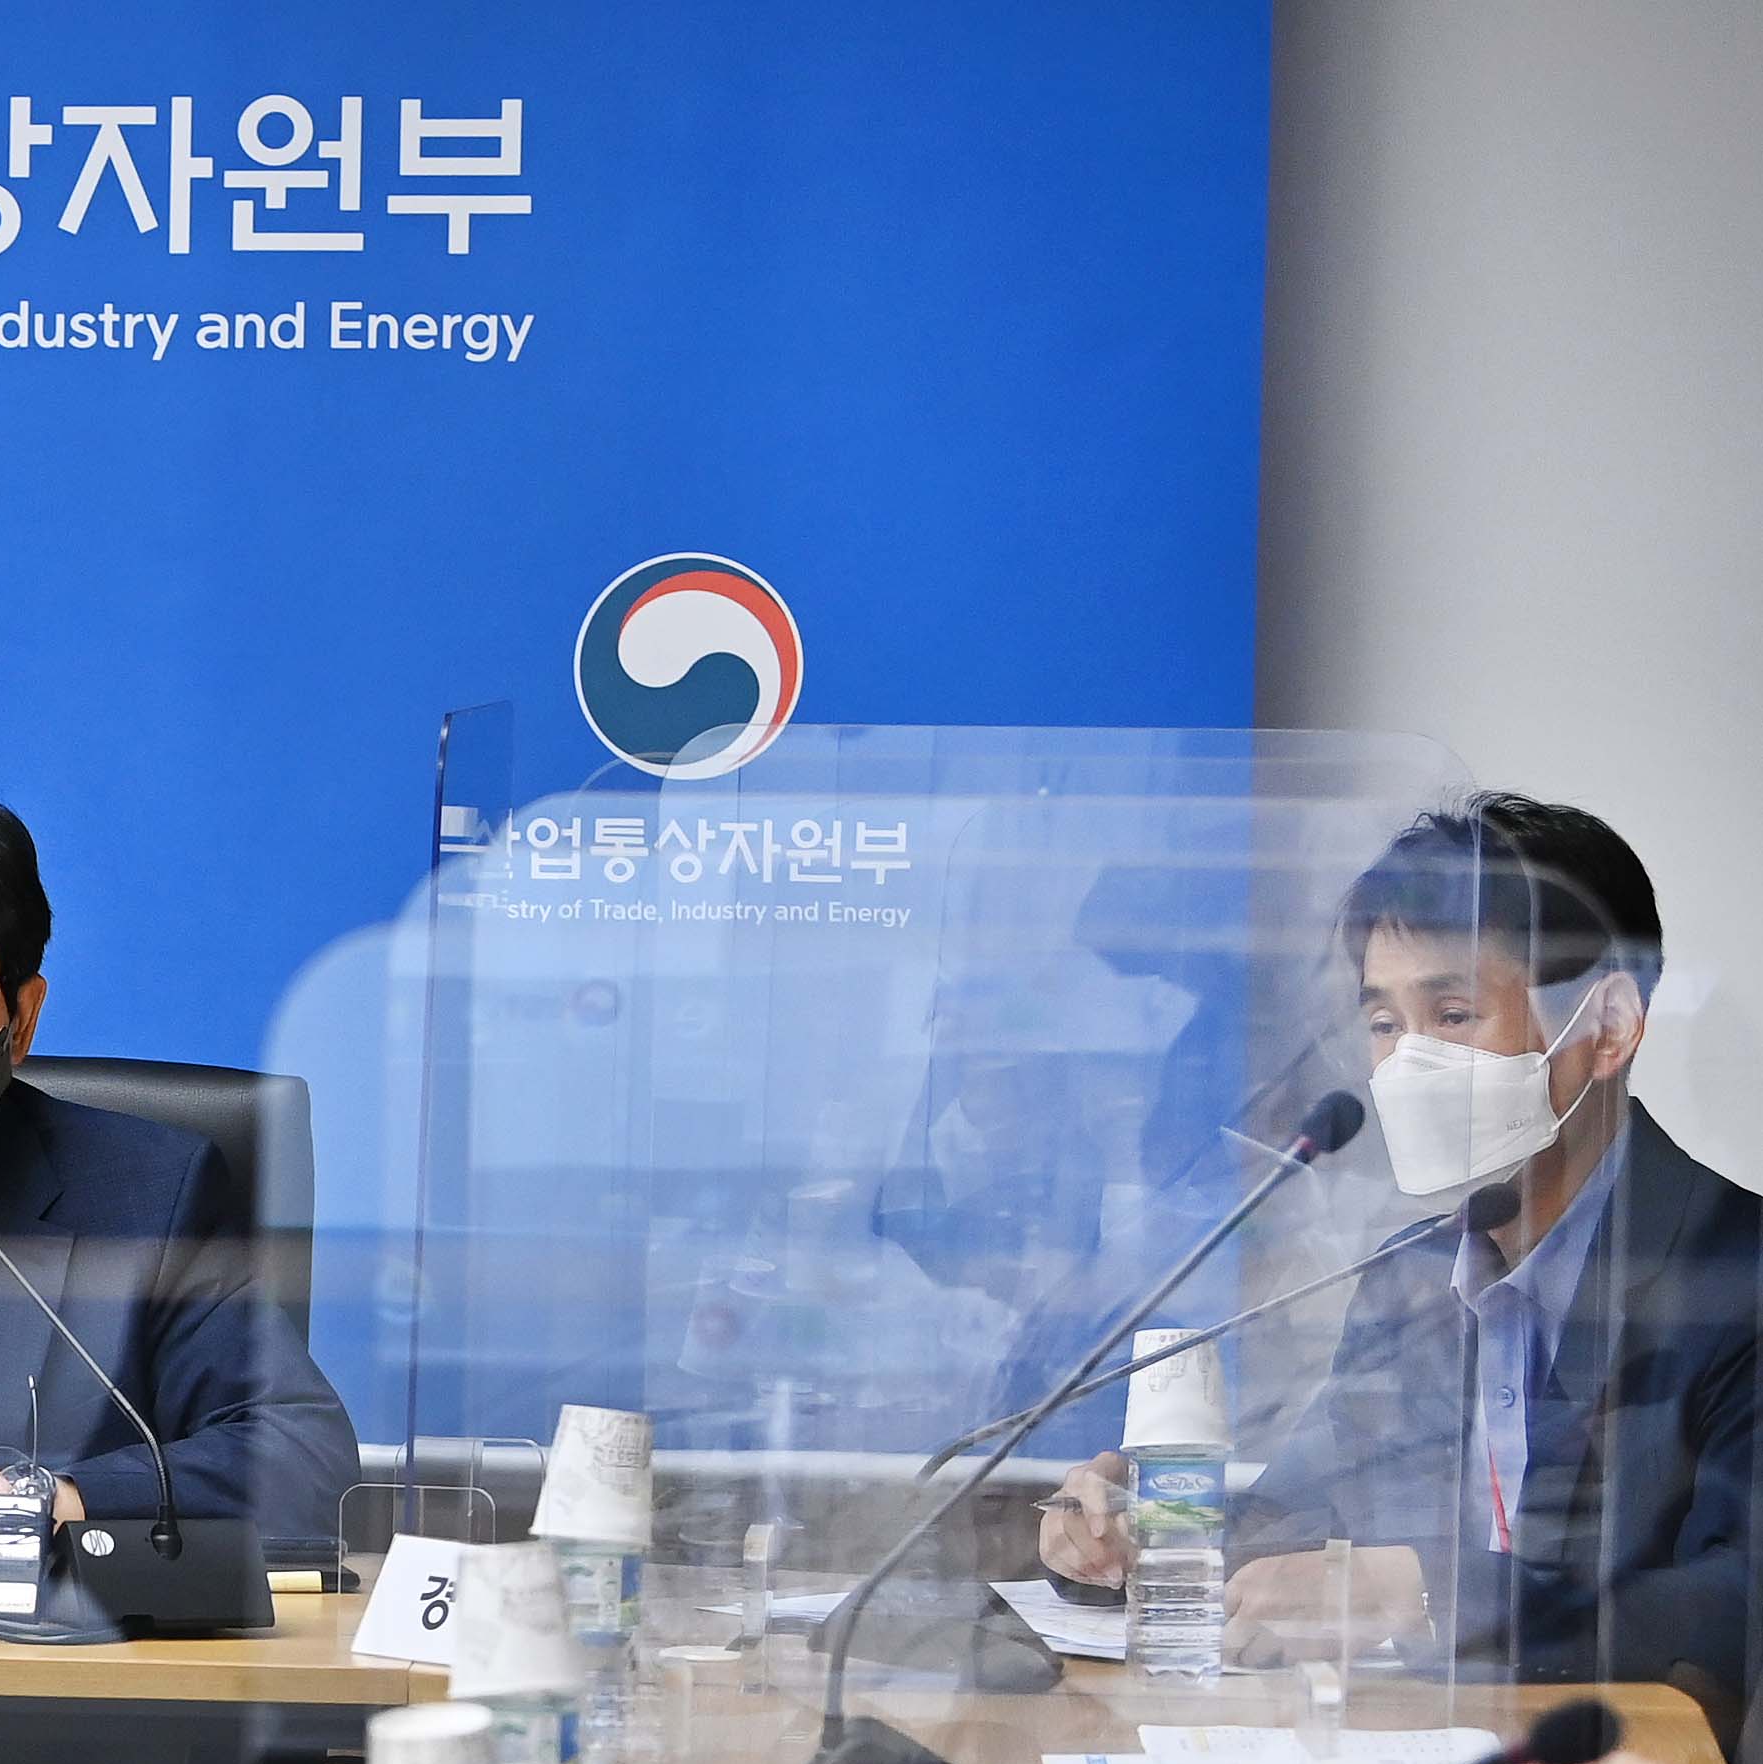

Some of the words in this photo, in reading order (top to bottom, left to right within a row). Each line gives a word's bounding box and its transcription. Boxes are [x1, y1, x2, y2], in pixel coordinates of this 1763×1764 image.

[195, 301, 305, 350] and
[330, 301, 535, 363] Energy
[559, 898, 582, 920] of
[590, 899, 664, 924] Trade,
[672, 899, 766, 925] Industry
[775, 900, 818, 922] and
[829, 901, 911, 928] Energy
